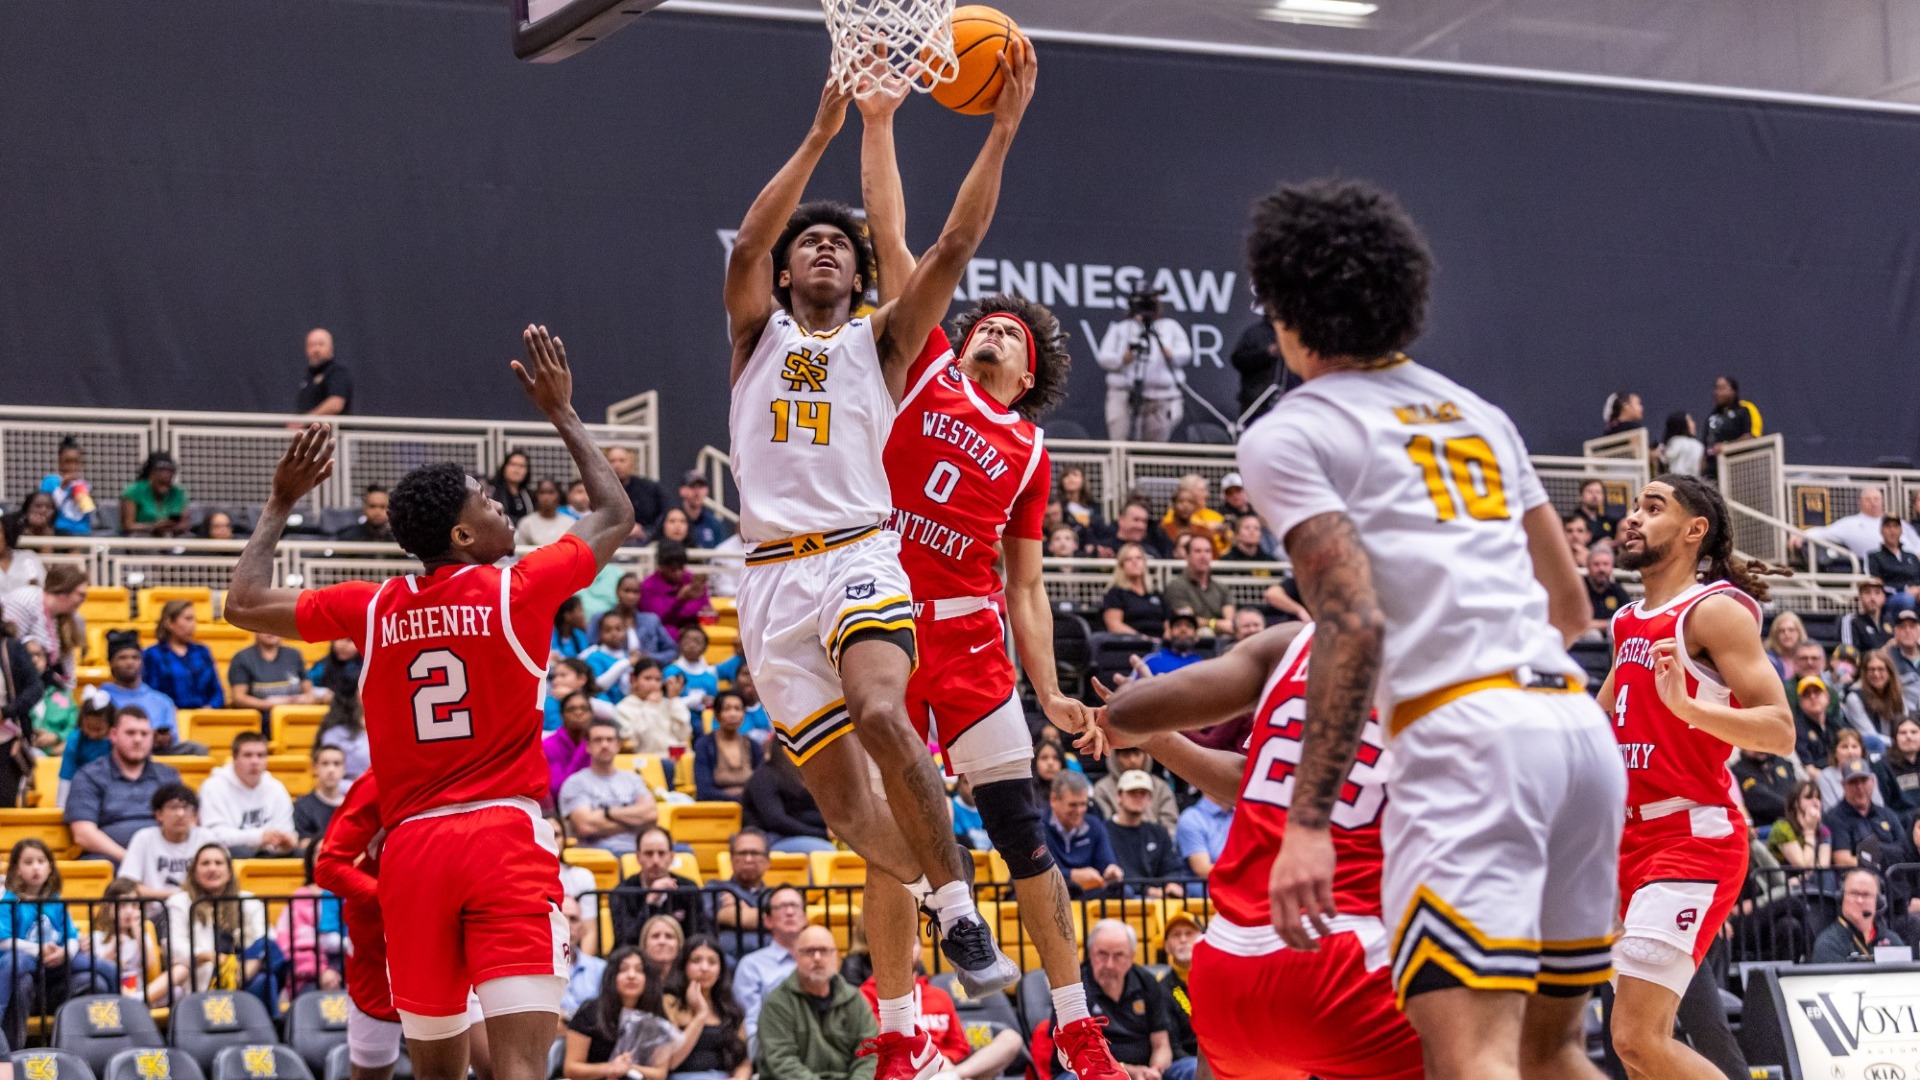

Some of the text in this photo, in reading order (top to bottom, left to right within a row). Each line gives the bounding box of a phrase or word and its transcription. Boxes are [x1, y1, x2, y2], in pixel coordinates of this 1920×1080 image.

[951, 257, 1237, 314] ENNESAW
[770, 398, 831, 446] 14
[921, 411, 1009, 482] WESTERN
[922, 460, 962, 504] 0
[1404, 433, 1511, 524] 10
[381, 605, 493, 648] McHENRY
[1615, 637, 1656, 671] ESTERN
[407, 647, 475, 744] 2
[1615, 683, 1630, 727] 4
[1805, 1006, 1823, 1020] ED
[1871, 1069, 1900, 1080] KIA
